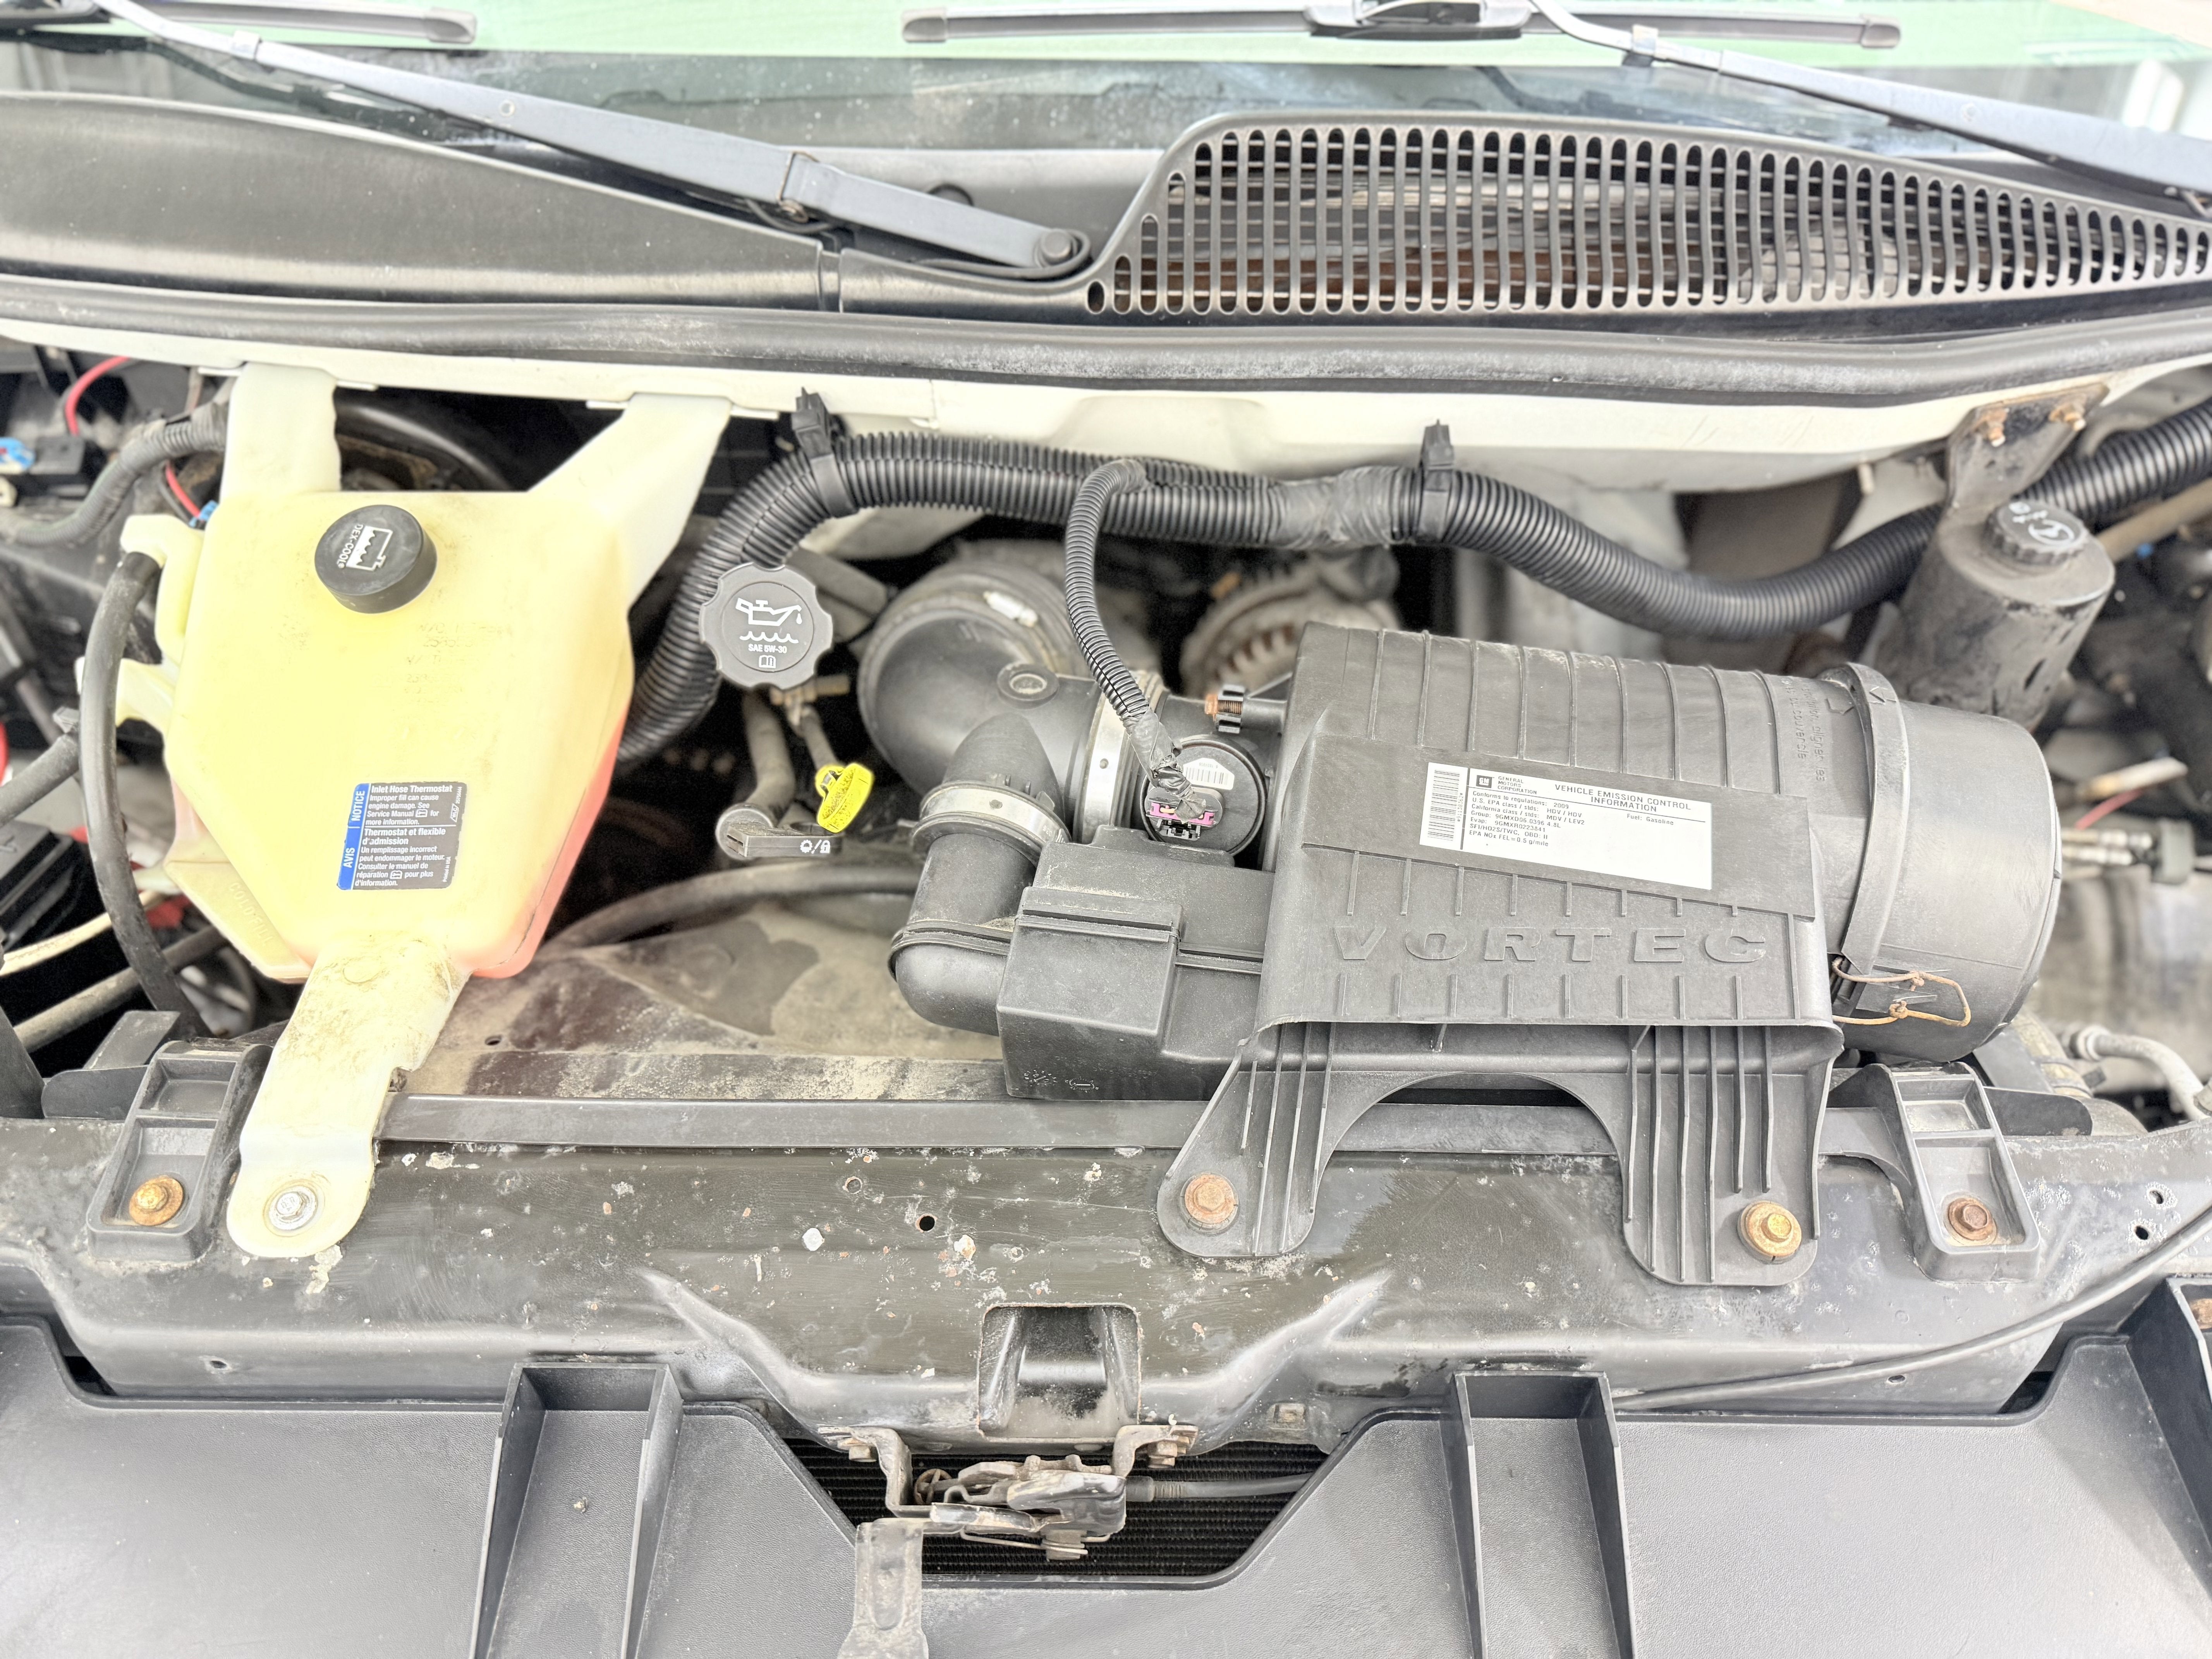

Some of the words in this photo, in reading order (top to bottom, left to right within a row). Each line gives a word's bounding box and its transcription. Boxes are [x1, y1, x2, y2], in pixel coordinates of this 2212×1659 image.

[337, 524, 363, 565] DEX-COOL
[748, 644, 763, 652] SAE
[764, 645, 787, 653] 5W-30
[1479, 777, 1489, 786] GM
[389, 785, 408, 793] Hose
[1498, 785, 1537, 794] CORPORATION
[1473, 791, 1501, 799] Conforms
[1511, 797, 1547, 806] regulations:
[1555, 784, 1594, 795] VEHICLE
[1597, 790, 1643, 803] EMISSION
[1647, 798, 1691, 810] CONTROL
[351, 790, 365, 821] NOTICE
[1472, 804, 1501, 812] California
[1591, 797, 1657, 812] INFORMATION
[1495, 814, 1544, 825] 9GMXD06.0396
[1646, 817, 1674, 825] Gasoline
[1495, 821, 1545, 832] 9GMXR0223841
[343, 847, 355, 868] AVIS
[356, 871, 388, 879] réparation
[229, 882, 256, 915] COLD
[248, 917, 273, 946] FILL
[1334, 927, 1766, 963] VORTEC
